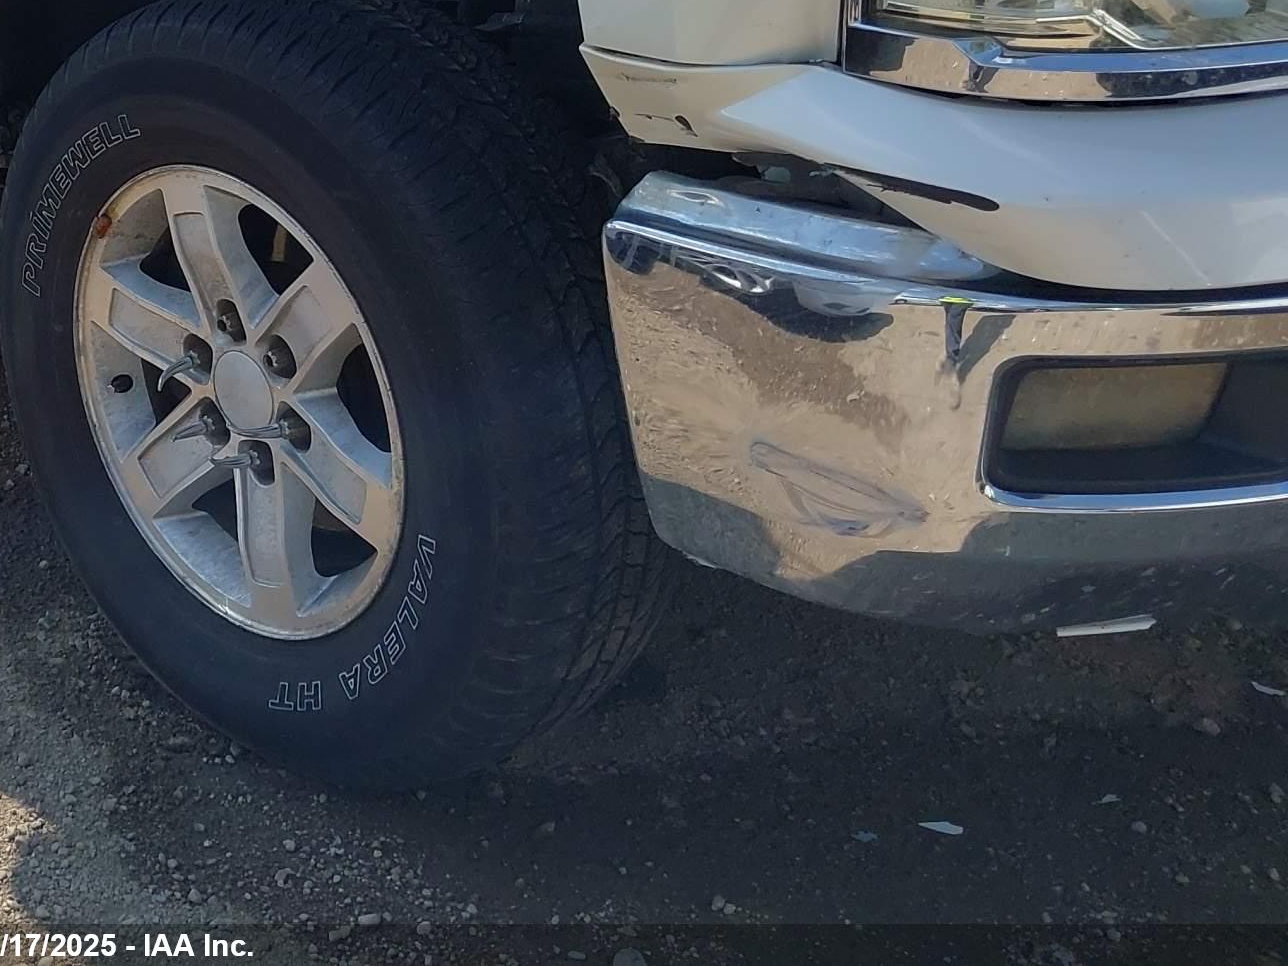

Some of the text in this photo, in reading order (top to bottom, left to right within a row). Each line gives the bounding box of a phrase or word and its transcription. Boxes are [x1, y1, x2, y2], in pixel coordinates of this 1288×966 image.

[21, 114, 141, 297] PRIMEWELL
[268, 534, 437, 712] VALERA HT
